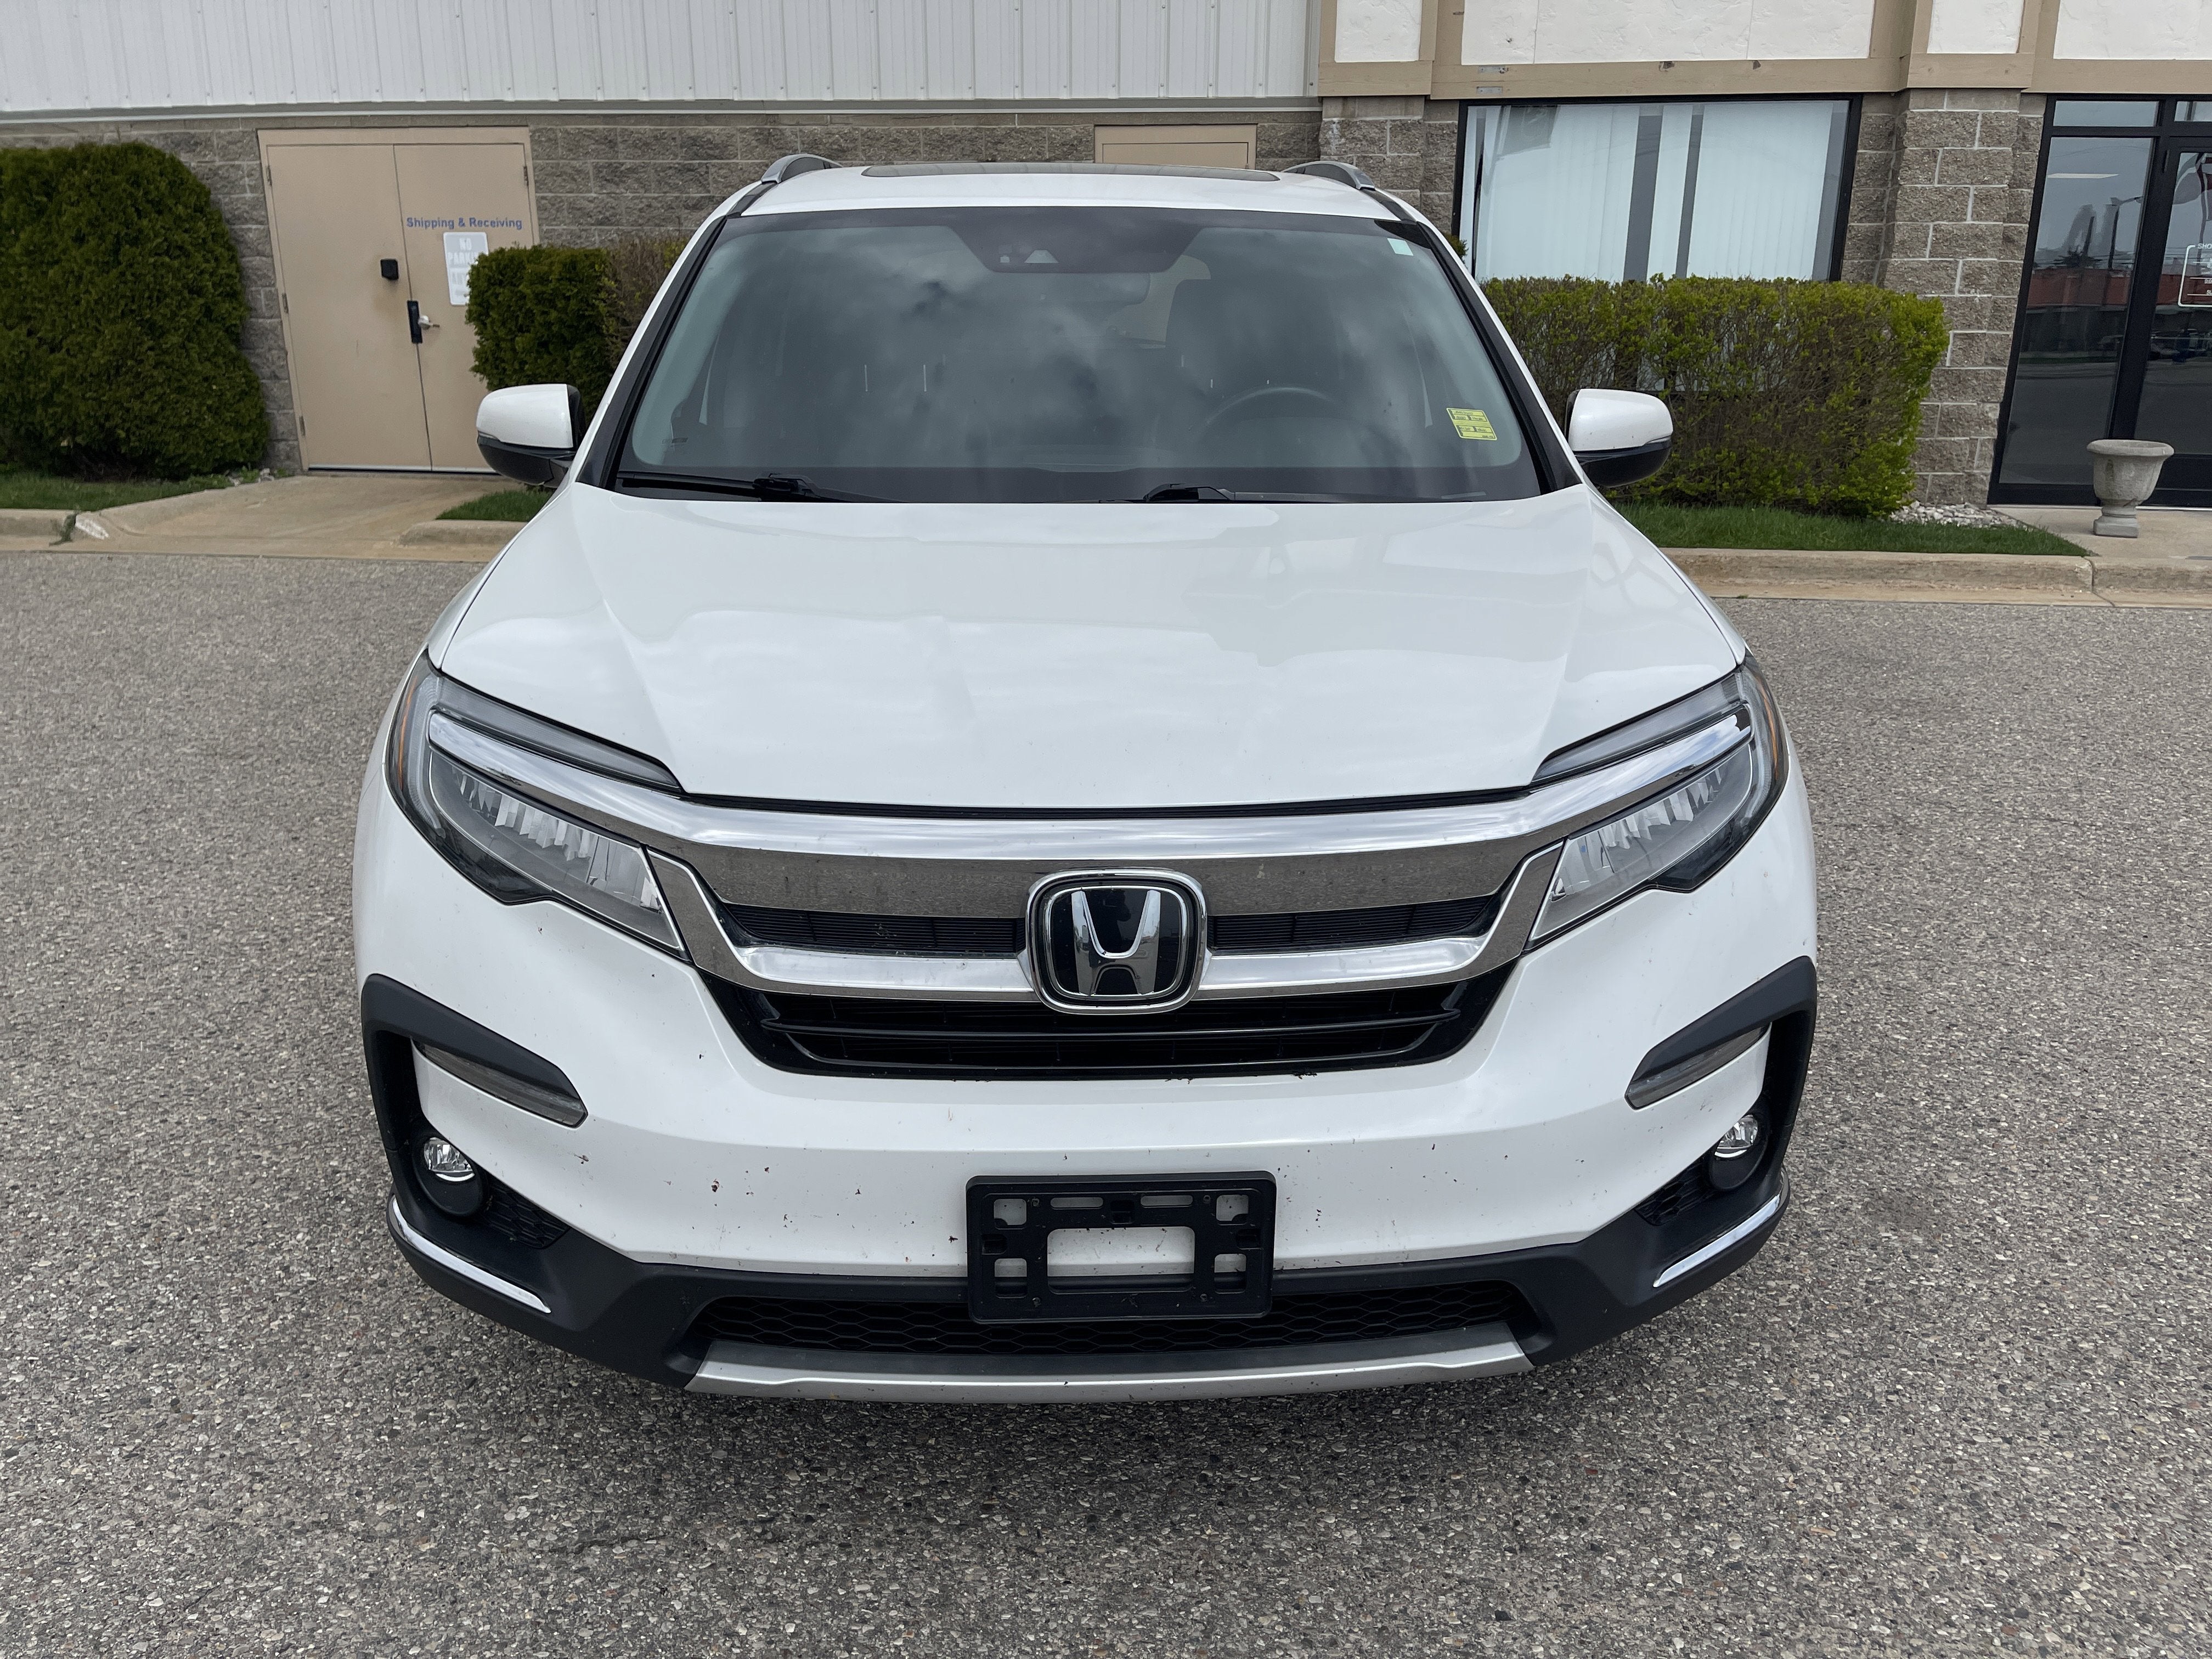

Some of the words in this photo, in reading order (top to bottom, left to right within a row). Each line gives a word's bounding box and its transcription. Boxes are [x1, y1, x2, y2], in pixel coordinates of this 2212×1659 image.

[407, 217, 454, 229] Shipping
[459, 217, 466, 227] &
[469, 217, 522, 230] Receiving
[459, 237, 472, 250] NO
[447, 252, 479, 265] PARKI
